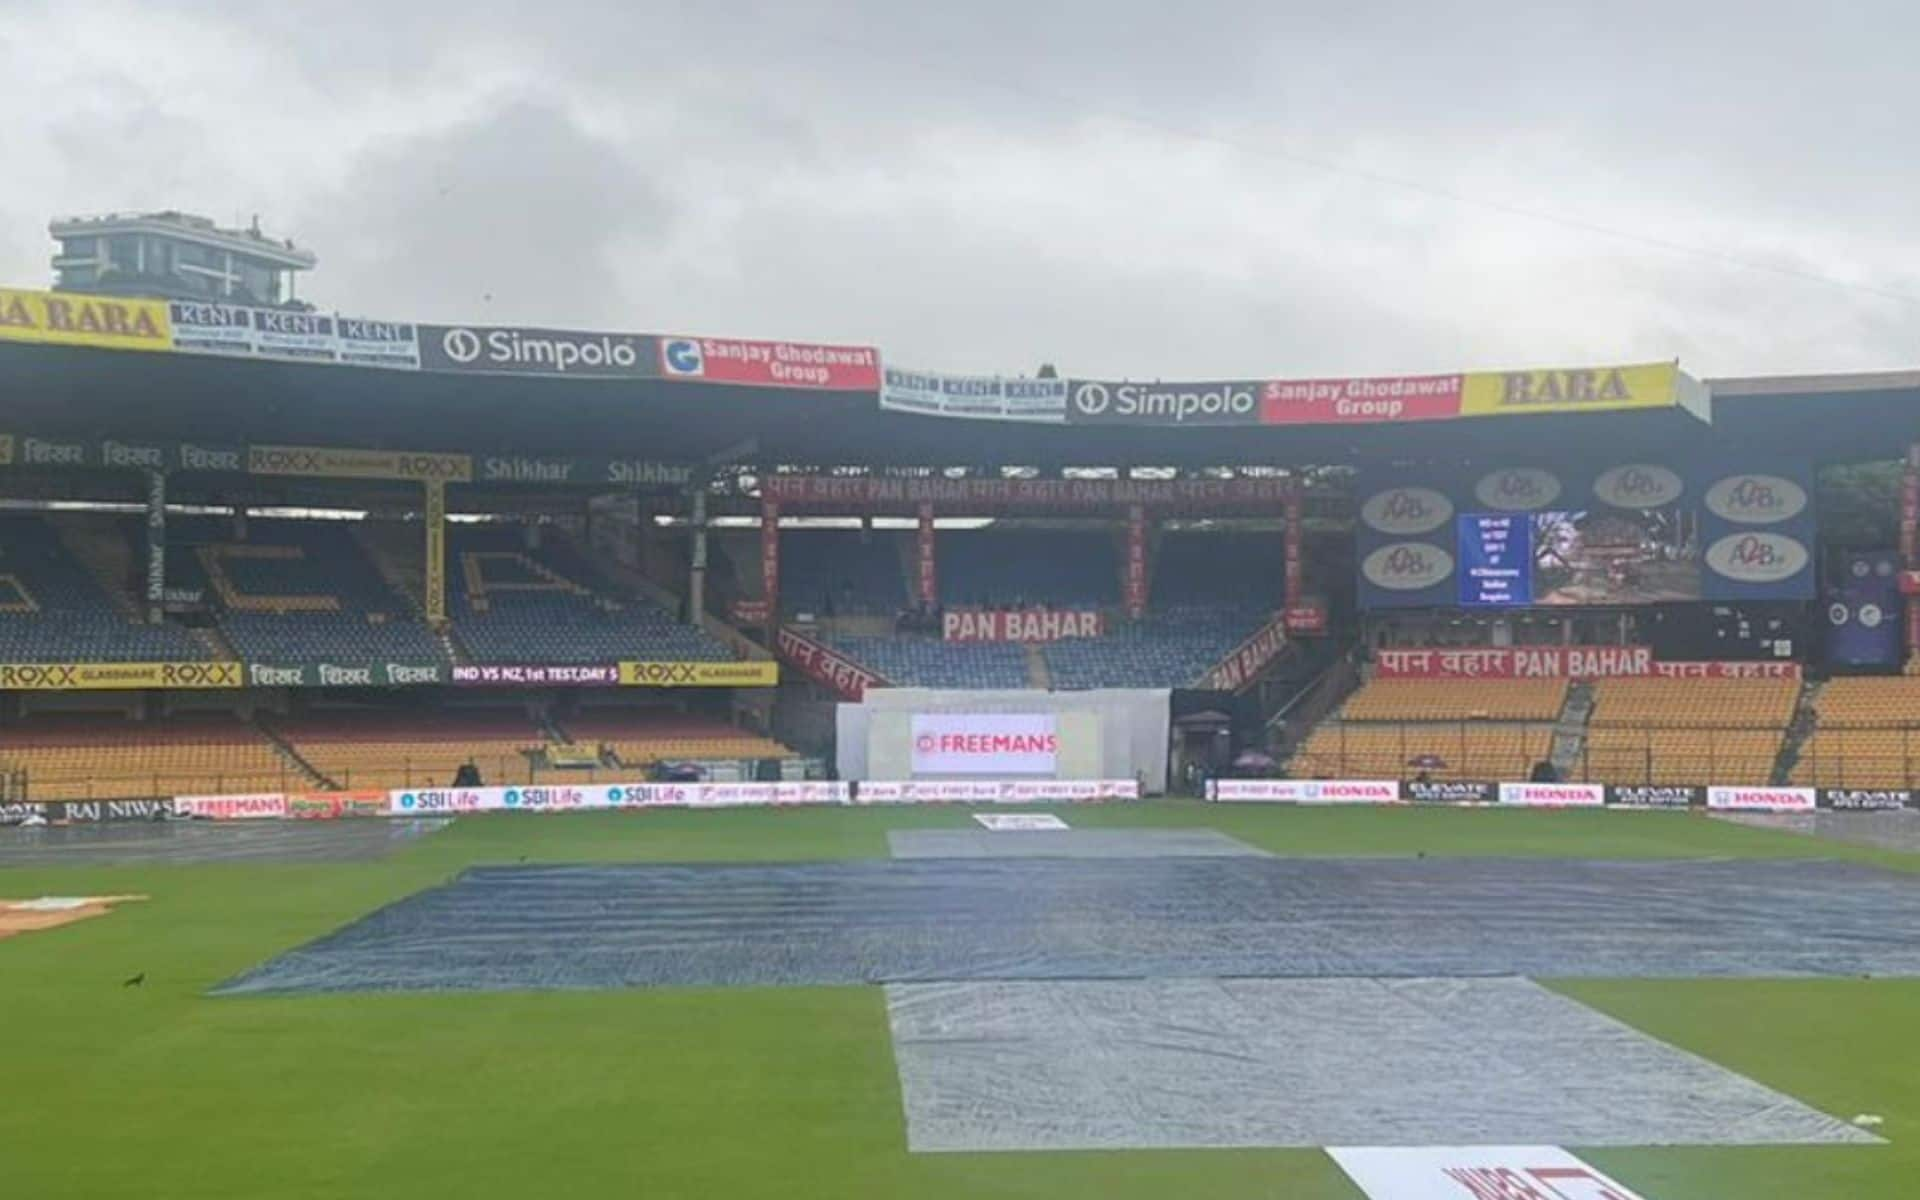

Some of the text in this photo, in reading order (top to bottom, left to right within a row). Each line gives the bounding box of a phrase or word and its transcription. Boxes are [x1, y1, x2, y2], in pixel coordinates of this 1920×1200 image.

[182, 306, 236, 327] KENT
[265, 313, 319, 334] KENT
[348, 320, 400, 341] KENT
[488, 331, 635, 371] Simpolo
[704, 339, 873, 366] Sanjay Ghodawat
[770, 361, 829, 383] Group
[1266, 376, 1460, 405] Sanjay Ghodawat
[1116, 385, 1254, 421] Simpolo
[1336, 399, 1403, 417] Group
[485, 457, 571, 481] Shikhar
[607, 460, 692, 483] Shikhar
[944, 611, 1097, 641] PAN BAHAR
[453, 667, 479, 681] IND
[481, 667, 500, 681] VS
[633, 664, 697, 684] ROXX
[1514, 650, 1560, 678] PAN
[1568, 649, 1650, 677] BAHAR
[2, 665, 77, 687] ROXX
[162, 664, 236, 685] ROXX
[941, 735, 1056, 752] FREEMANS
[418, 792, 480, 809] SBI Life
[521, 788, 583, 804] SBI Life
[625, 786, 686, 802] SBI Life
[1322, 785, 1391, 797] HONDA
[1525, 789, 1596, 801] HONDA
[1735, 793, 1808, 805] HONDA
[66, 802, 100, 819] RAJ
[197, 798, 284, 814] FREEMANS
